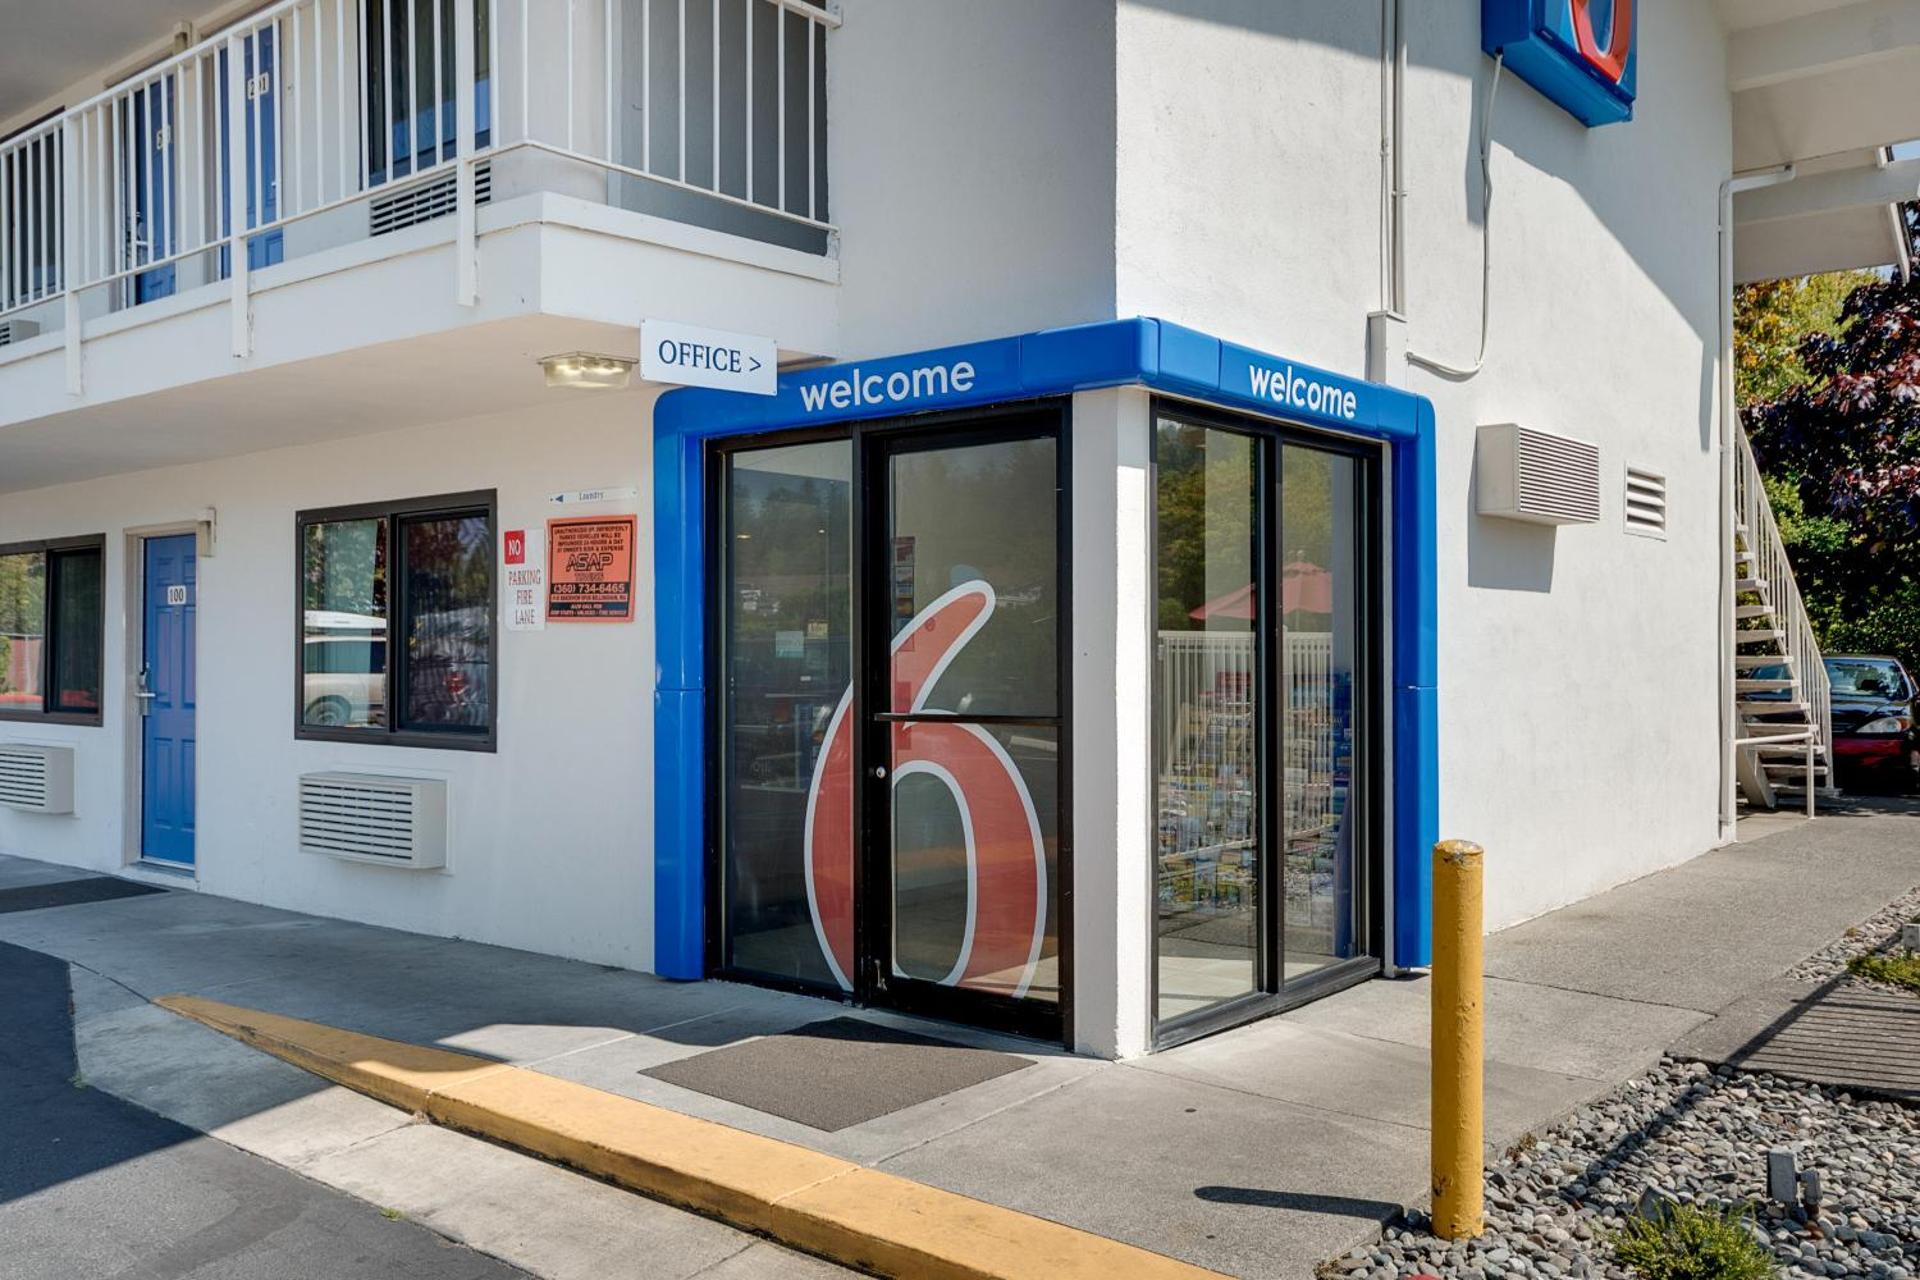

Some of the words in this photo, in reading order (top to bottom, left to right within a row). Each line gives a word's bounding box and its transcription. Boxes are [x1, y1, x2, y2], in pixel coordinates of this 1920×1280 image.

[659, 340, 741, 373] OFFICE
[800, 361, 975, 413] welcome
[1249, 364, 1356, 419] welcome
[579, 491, 604, 501] Laundry
[508, 539, 521, 556] NO
[566, 552, 613, 573] ASAP
[508, 569, 541, 586] PARKING
[169, 587, 184, 603] 100
[516, 589, 533, 605] FIRE
[515, 609, 535, 625] LANE
[804, 579, 1047, 999] 6
